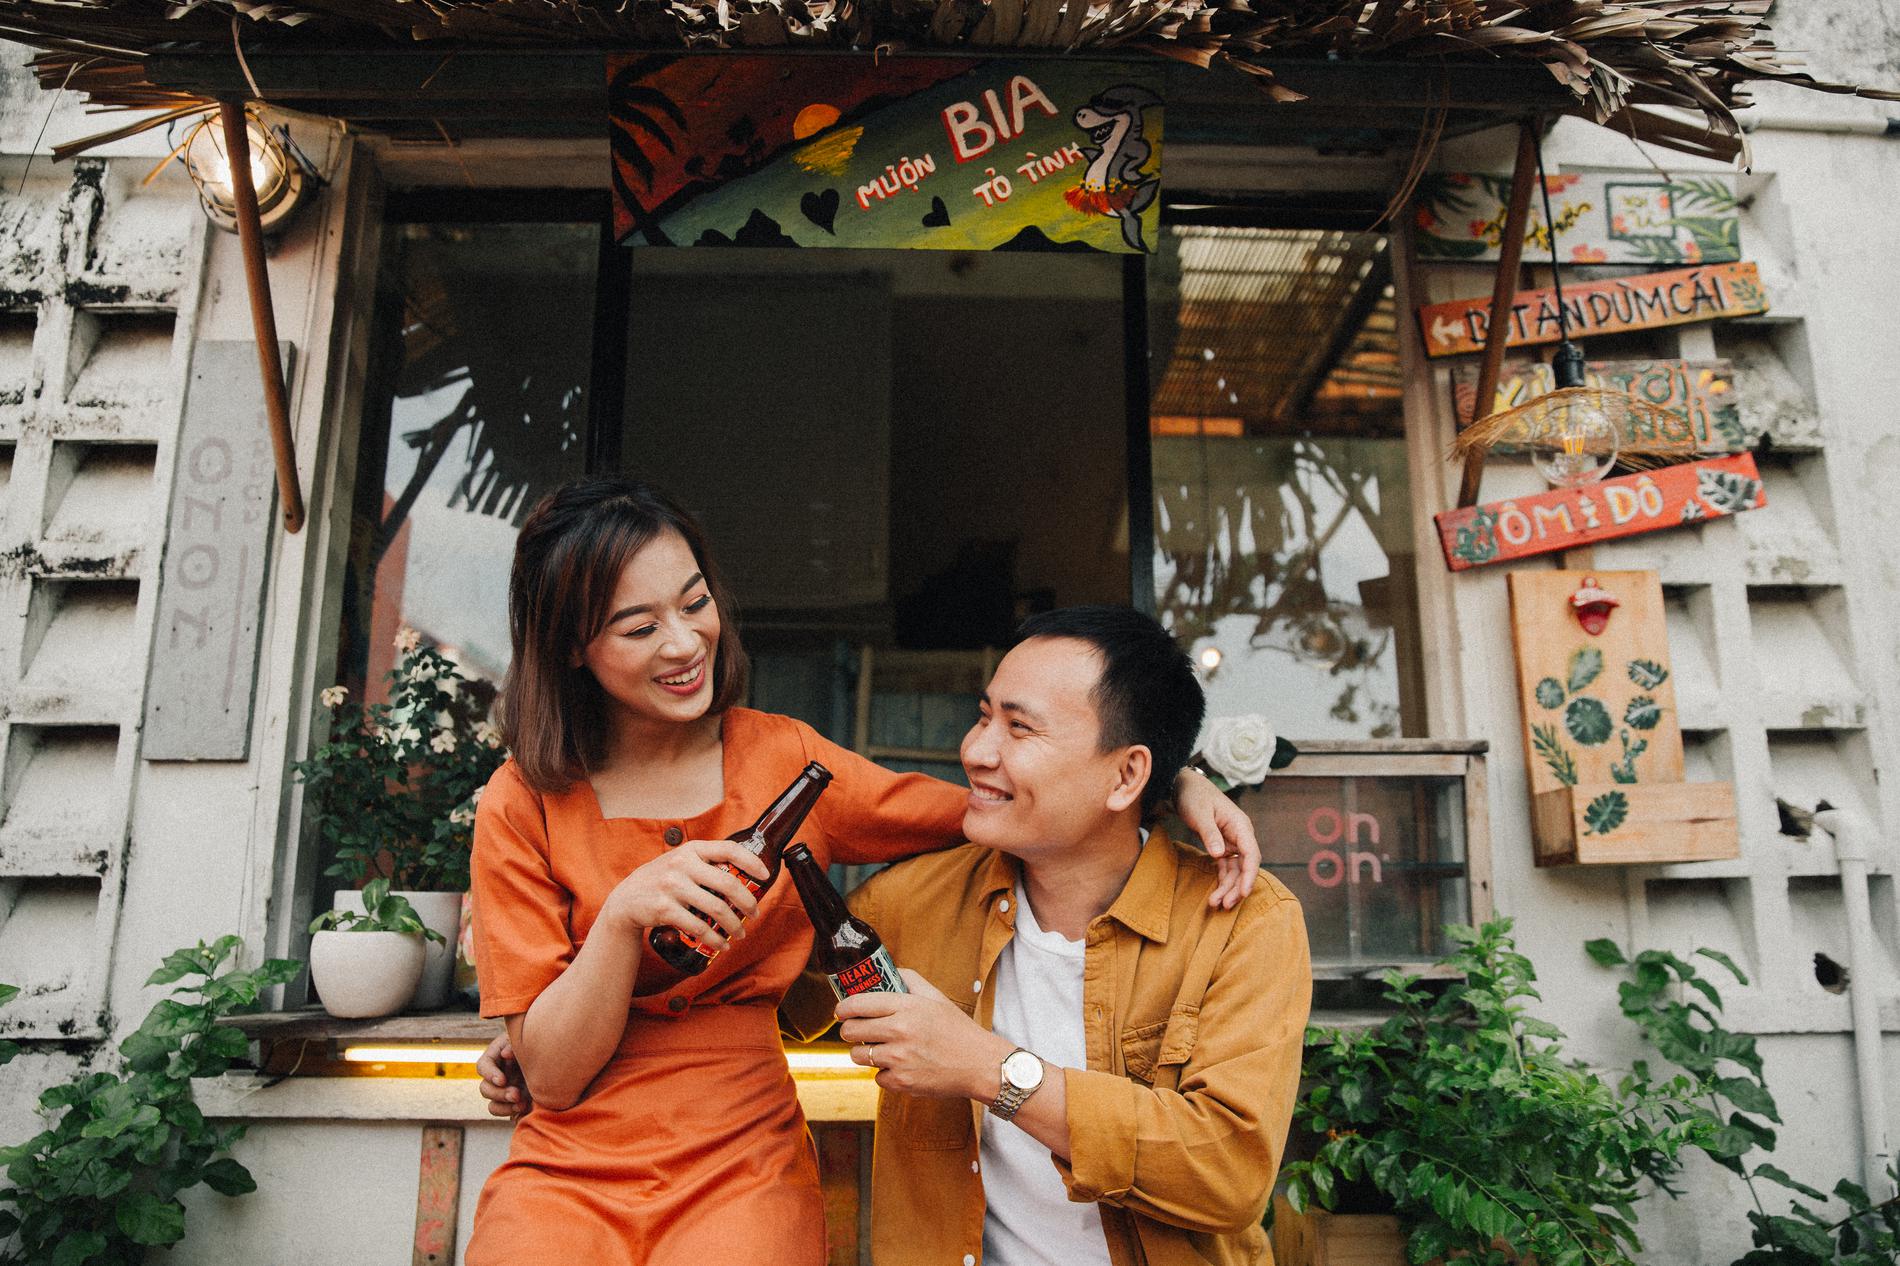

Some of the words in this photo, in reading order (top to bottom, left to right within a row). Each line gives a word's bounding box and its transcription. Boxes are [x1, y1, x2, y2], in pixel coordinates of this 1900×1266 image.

[941, 75, 1059, 164] BIA
[1306, 806, 1380, 846] on
[839, 959, 875, 986] HEART
